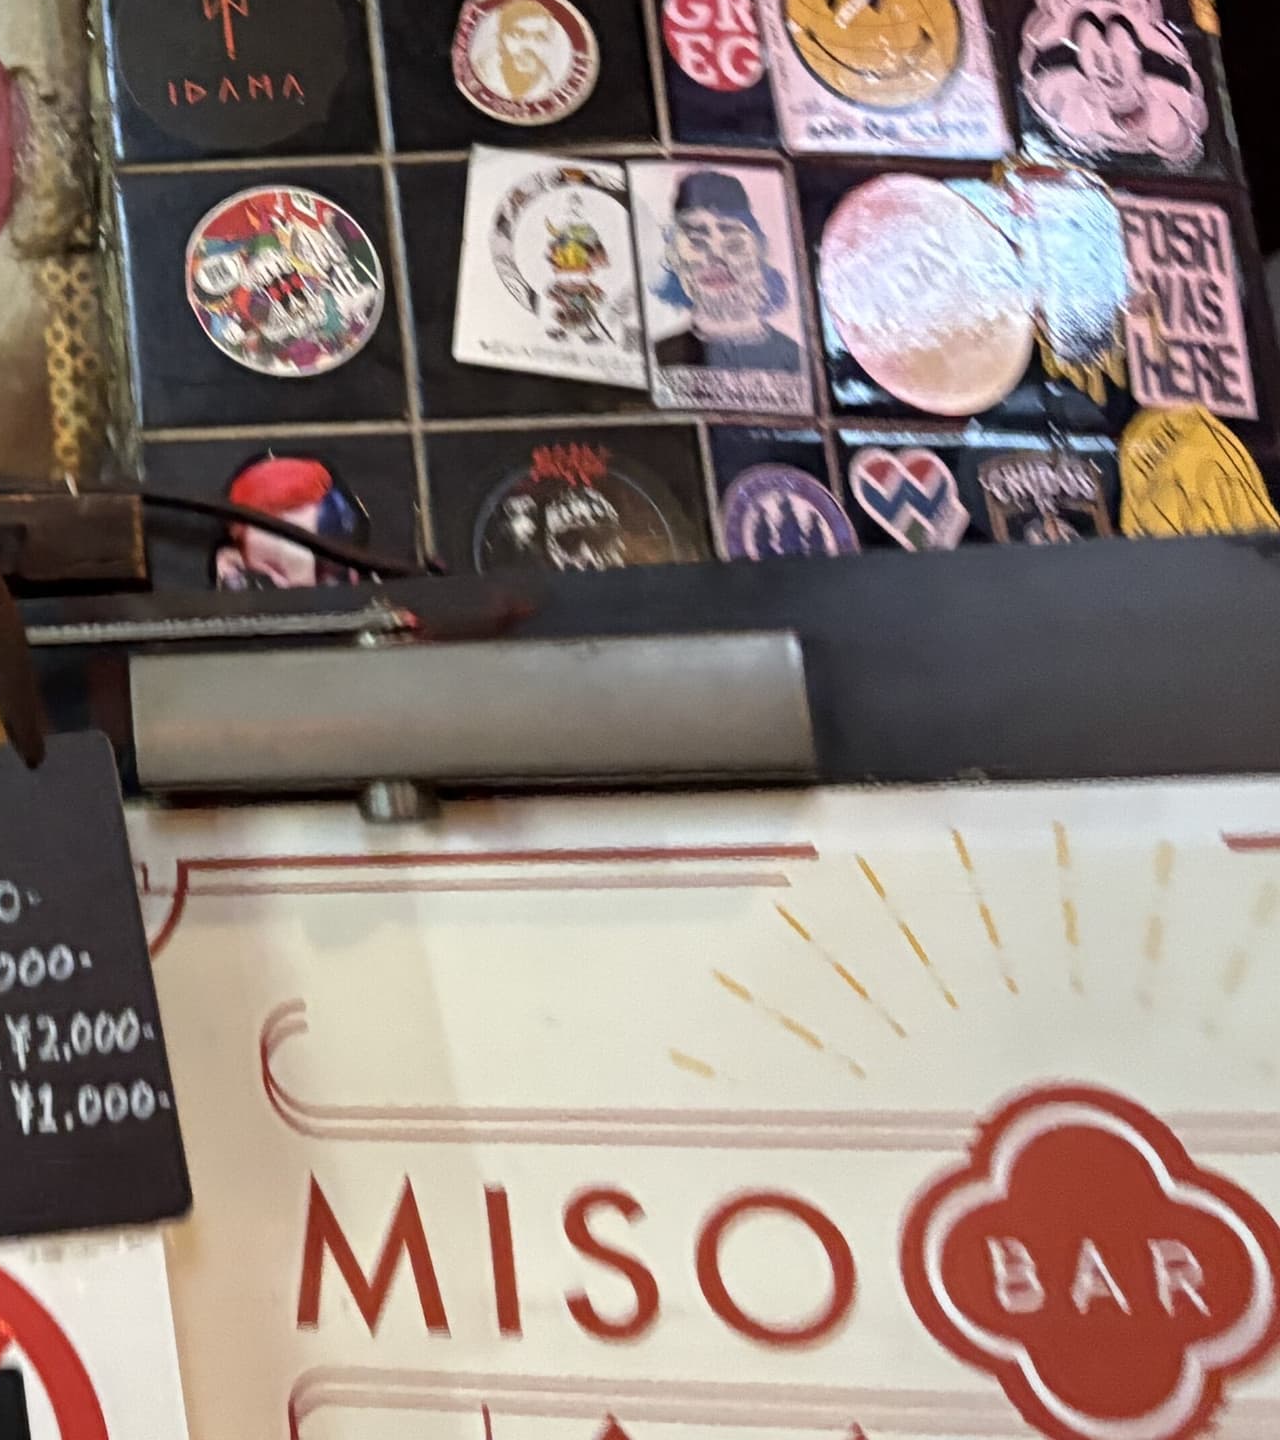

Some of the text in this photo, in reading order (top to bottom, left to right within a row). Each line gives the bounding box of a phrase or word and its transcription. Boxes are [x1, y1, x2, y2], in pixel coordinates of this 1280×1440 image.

[169, 71, 305, 107] IDAMA
[1134, 336, 1246, 405] HERE
[296, 1170, 1214, 1344] MISO BAR
